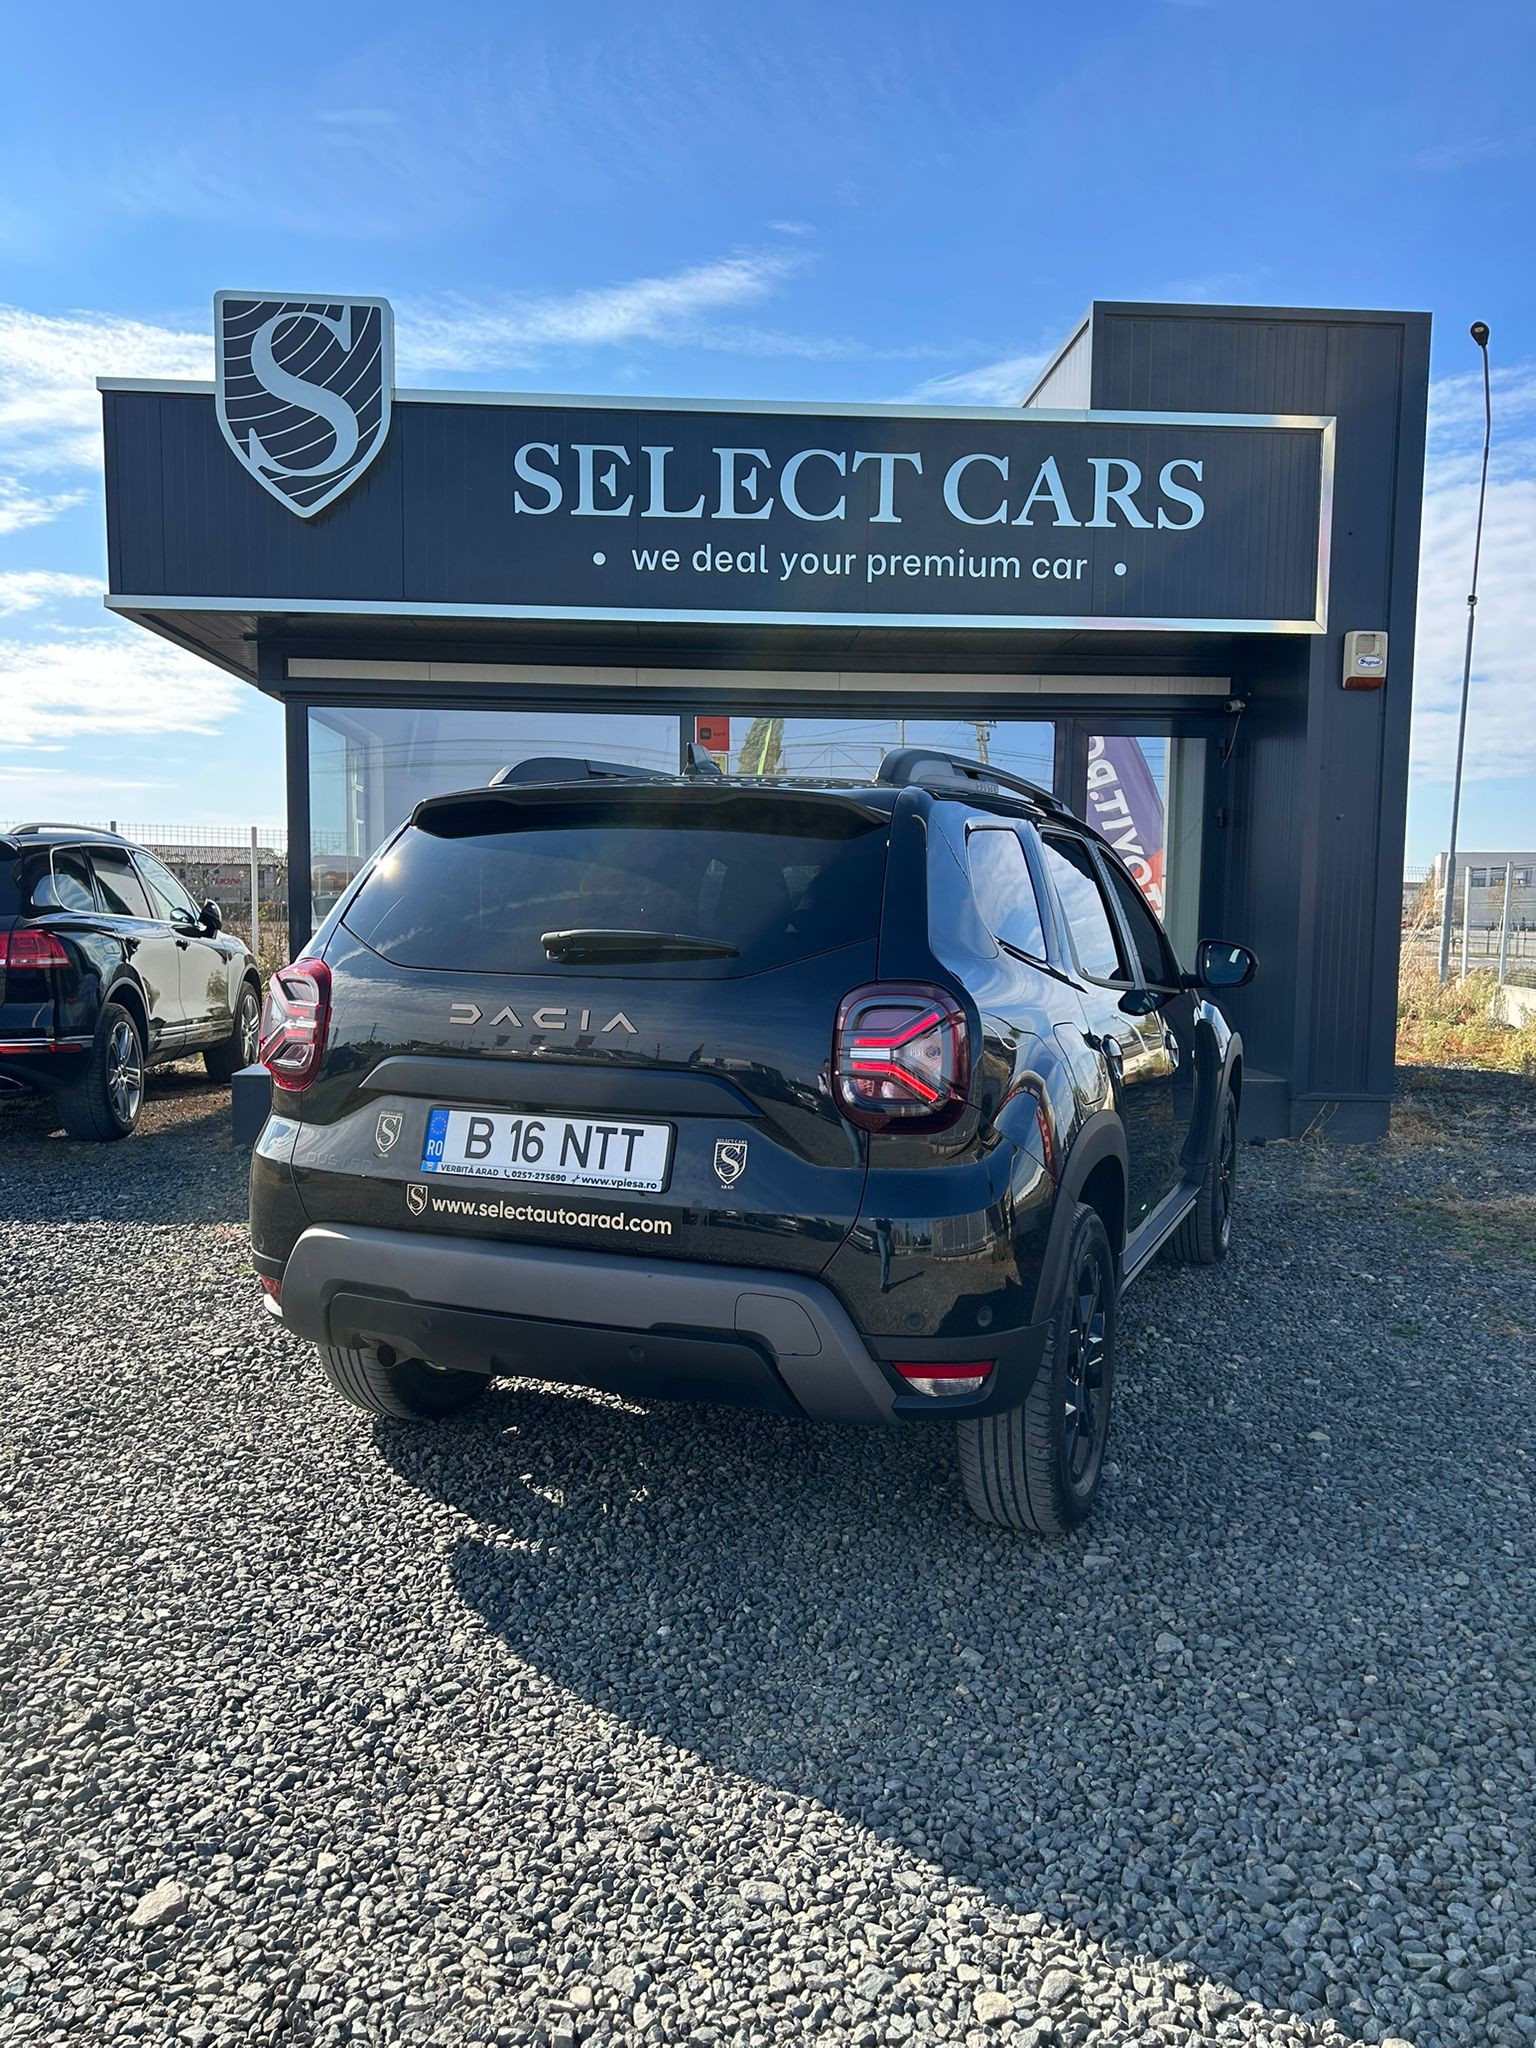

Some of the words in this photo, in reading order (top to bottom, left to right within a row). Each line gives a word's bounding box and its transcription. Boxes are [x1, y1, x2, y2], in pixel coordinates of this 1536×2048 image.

[513, 442, 924, 525] SELECT
[942, 453, 1207, 531] CARS
[631, 548, 681, 574] we
[691, 544, 769, 575] deal
[779, 549, 857, 582] your
[866, 549, 1021, 583] premium
[1030, 556, 1089, 581] car
[449, 1003, 640, 1035] DACIA
[426, 1139, 443, 1157] RO
[464, 1116, 495, 1160] B
[510, 1119, 546, 1164] 16
[559, 1123, 645, 1173] NTT
[512, 1170, 567, 1182] 0257-275690
[581, 1175, 658, 1190] www.vpiesa.ro
[432, 1198, 673, 1235] www.selectautoarad.com
